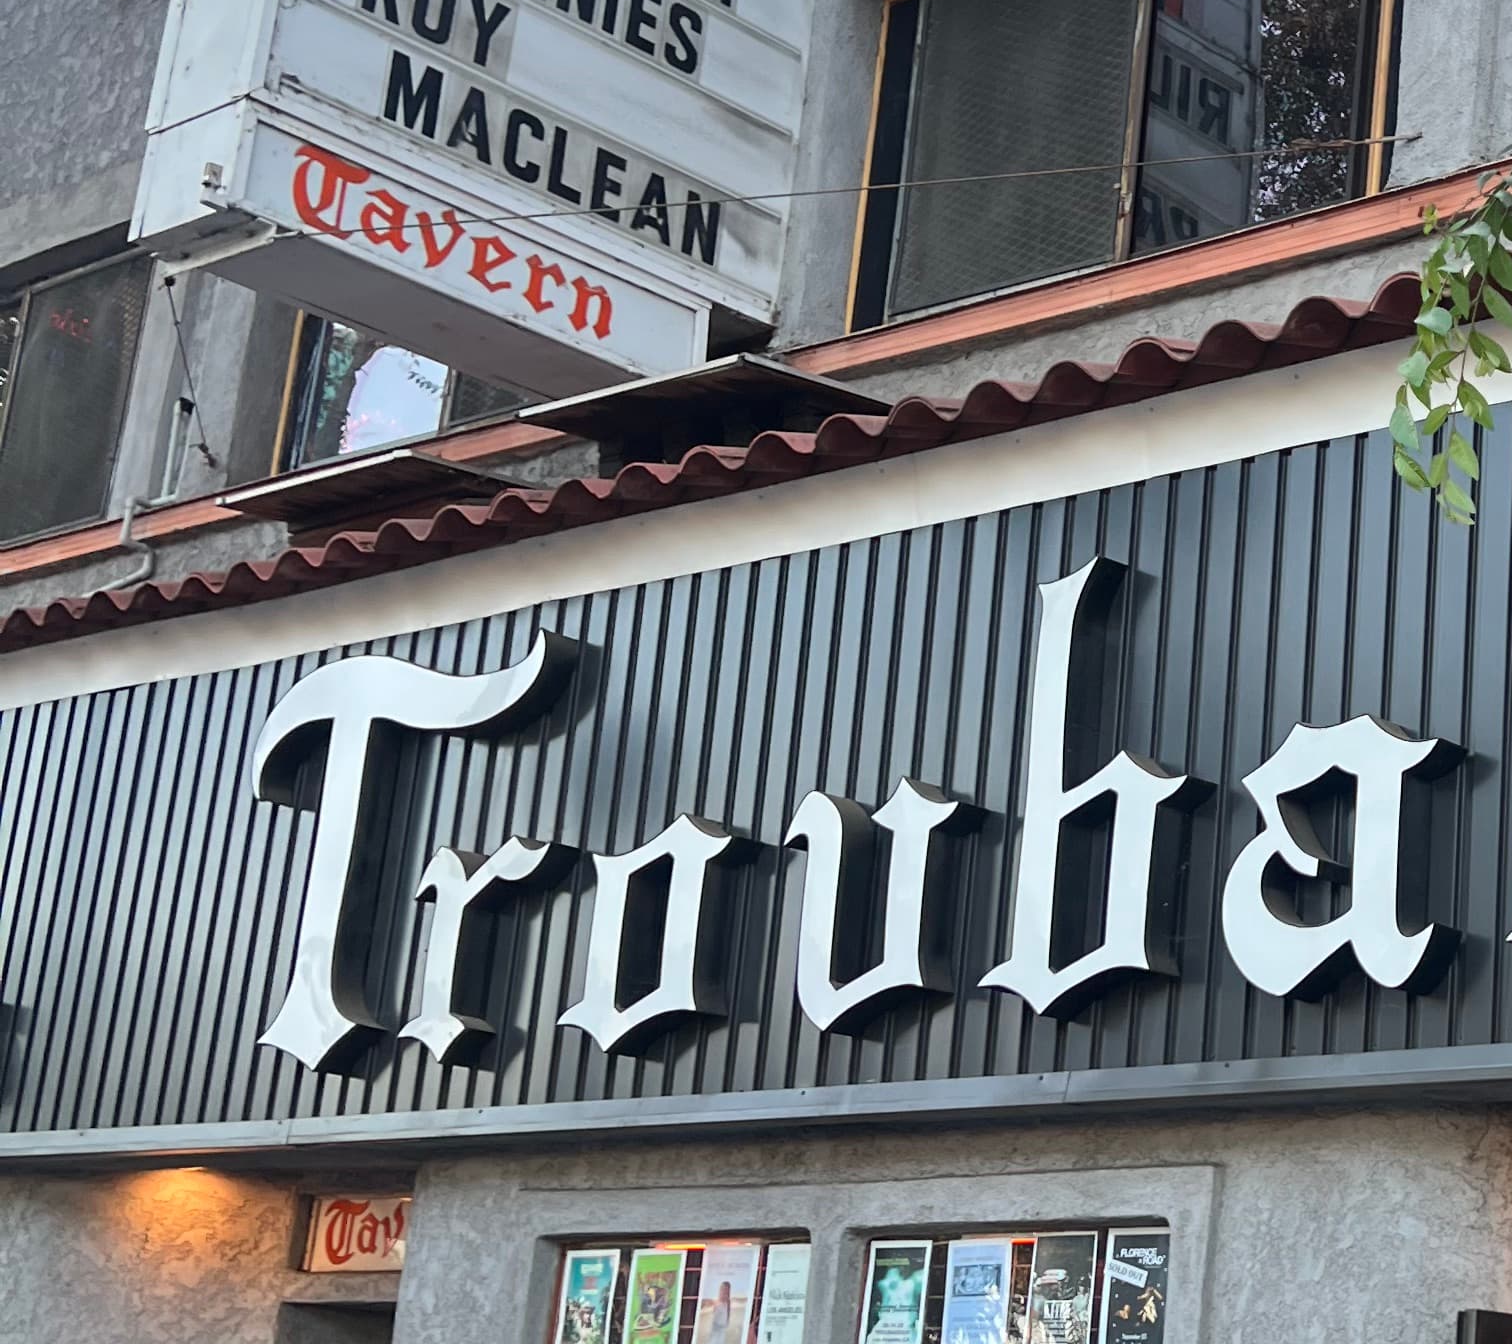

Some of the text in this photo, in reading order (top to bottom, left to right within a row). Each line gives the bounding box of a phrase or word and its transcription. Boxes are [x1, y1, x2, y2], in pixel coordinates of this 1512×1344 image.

[291, 145, 614, 340] Tavern
[383, 50, 722, 267] MACLEAN
[1107, 1262, 1144, 1282] SOLD OUT
